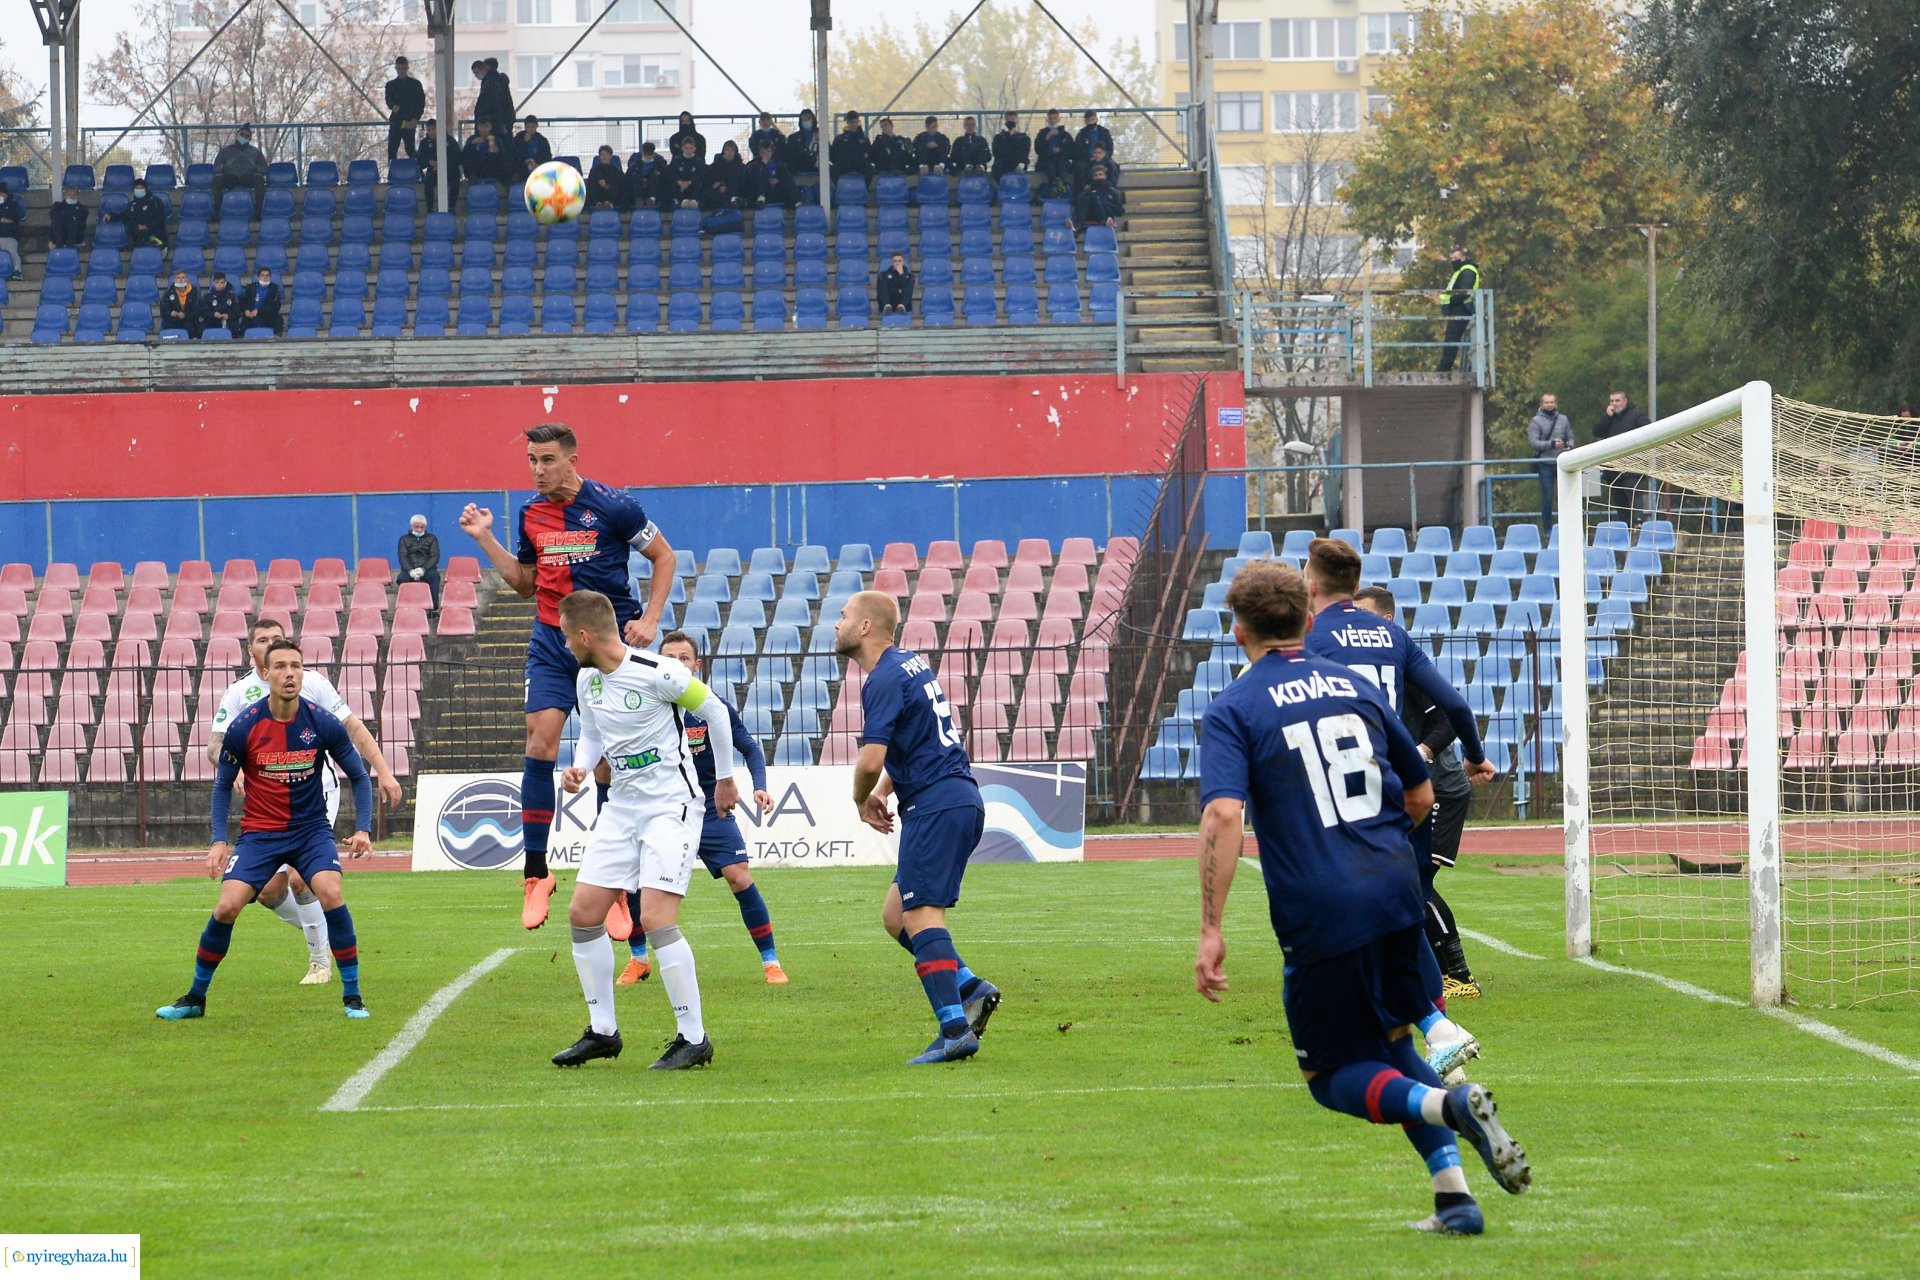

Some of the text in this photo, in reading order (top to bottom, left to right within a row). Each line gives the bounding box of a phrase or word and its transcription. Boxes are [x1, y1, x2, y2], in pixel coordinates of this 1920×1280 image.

[536, 530, 599, 547] REVESZ
[641, 528, 653, 541] C
[1331, 623, 1394, 648] VÉGSŐ
[1268, 670, 1358, 708] KOVÁCS
[256, 748, 318, 765] REVESZ
[1282, 713, 1382, 828] 18
[816, 840, 855, 858] KFT.
